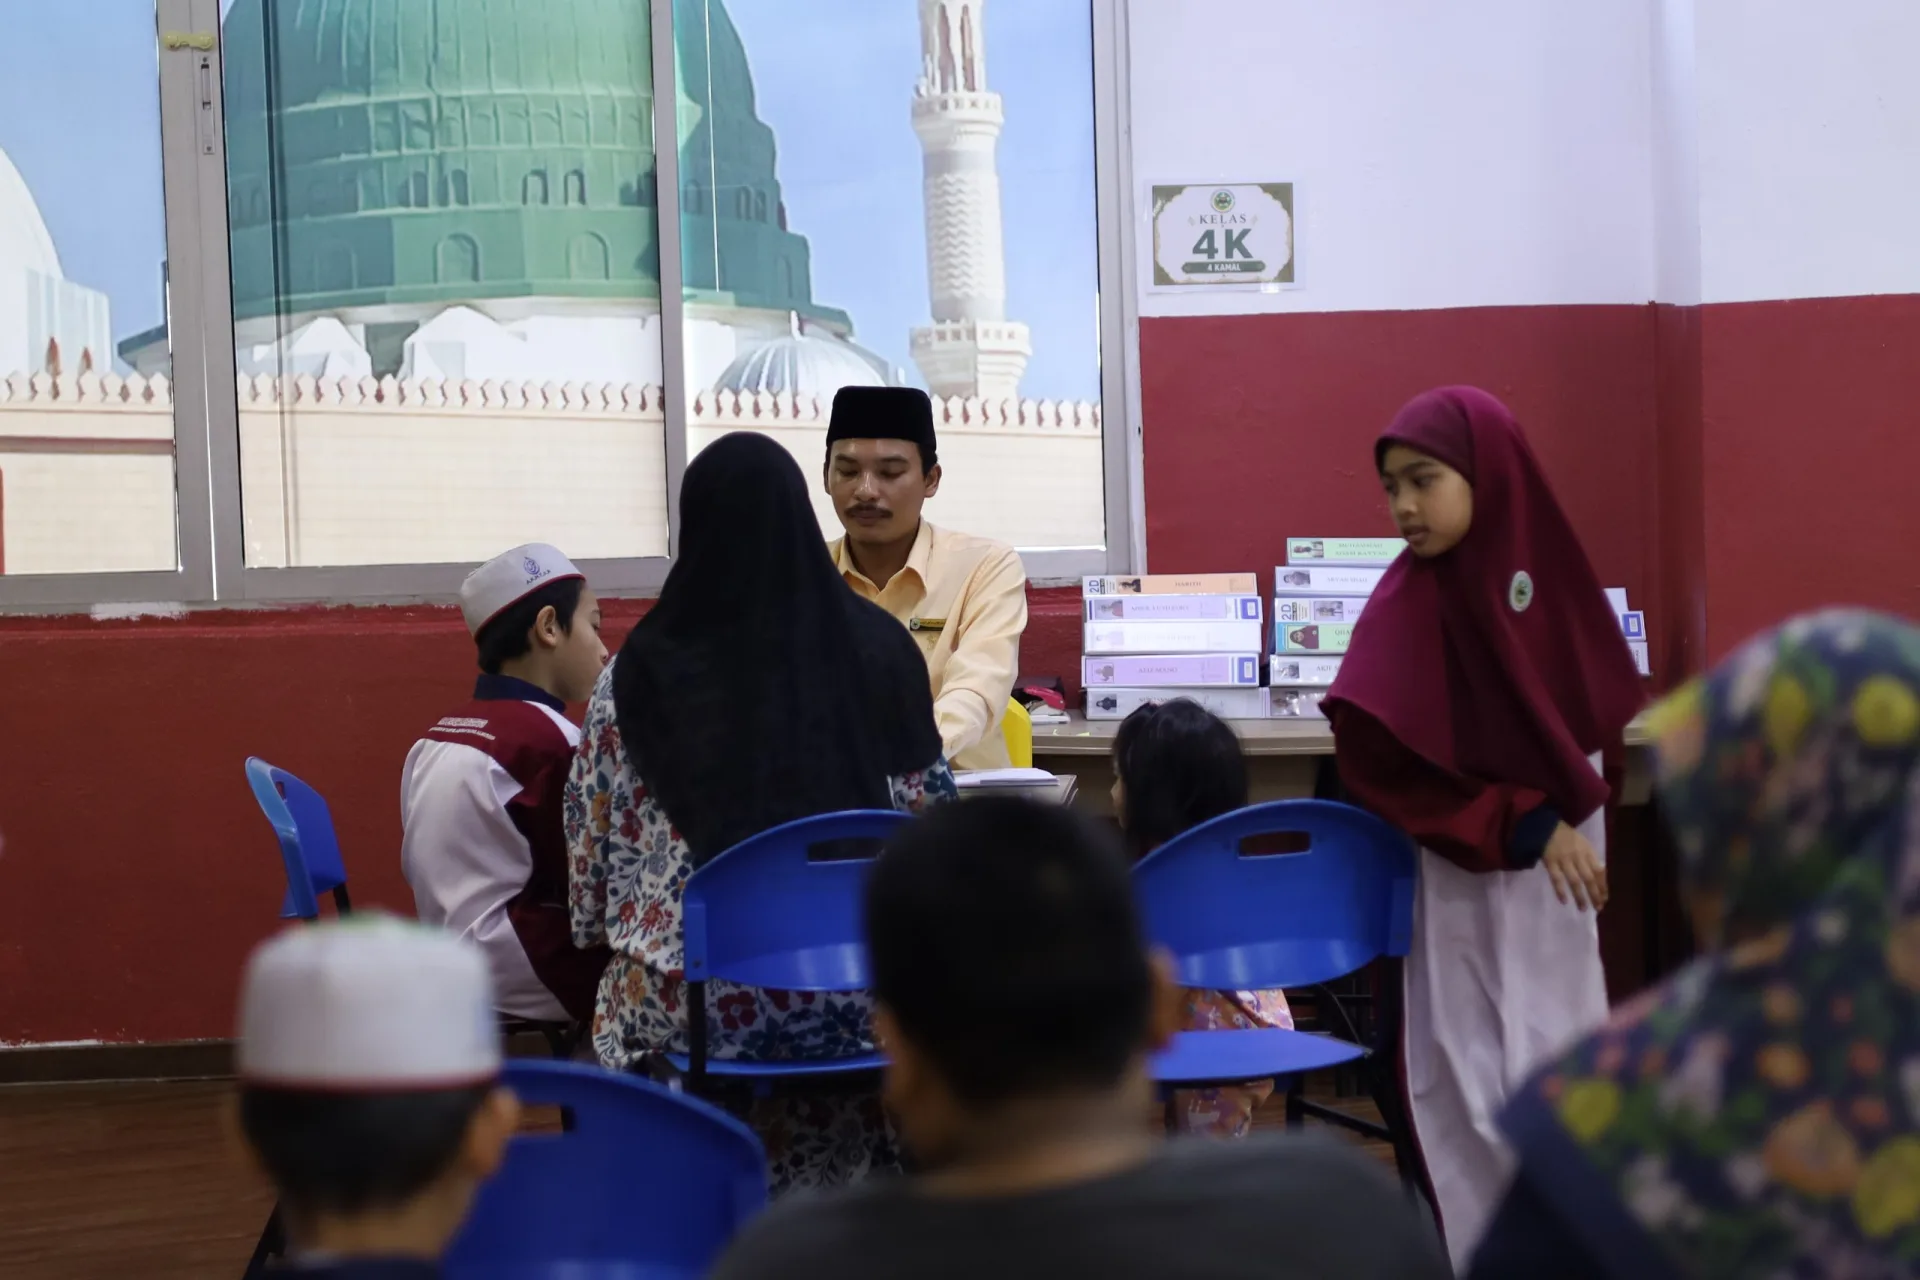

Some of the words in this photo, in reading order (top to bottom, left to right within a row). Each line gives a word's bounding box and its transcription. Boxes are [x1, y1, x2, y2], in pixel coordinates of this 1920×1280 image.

[1200, 214, 1247, 225] KELAS
[1192, 228, 1253, 259] 4K
[1207, 264, 1213, 272] 4
[1214, 264, 1241, 272] KAMAL
[1088, 579, 1100, 593] 2D
[1280, 603, 1292, 621] 2D
